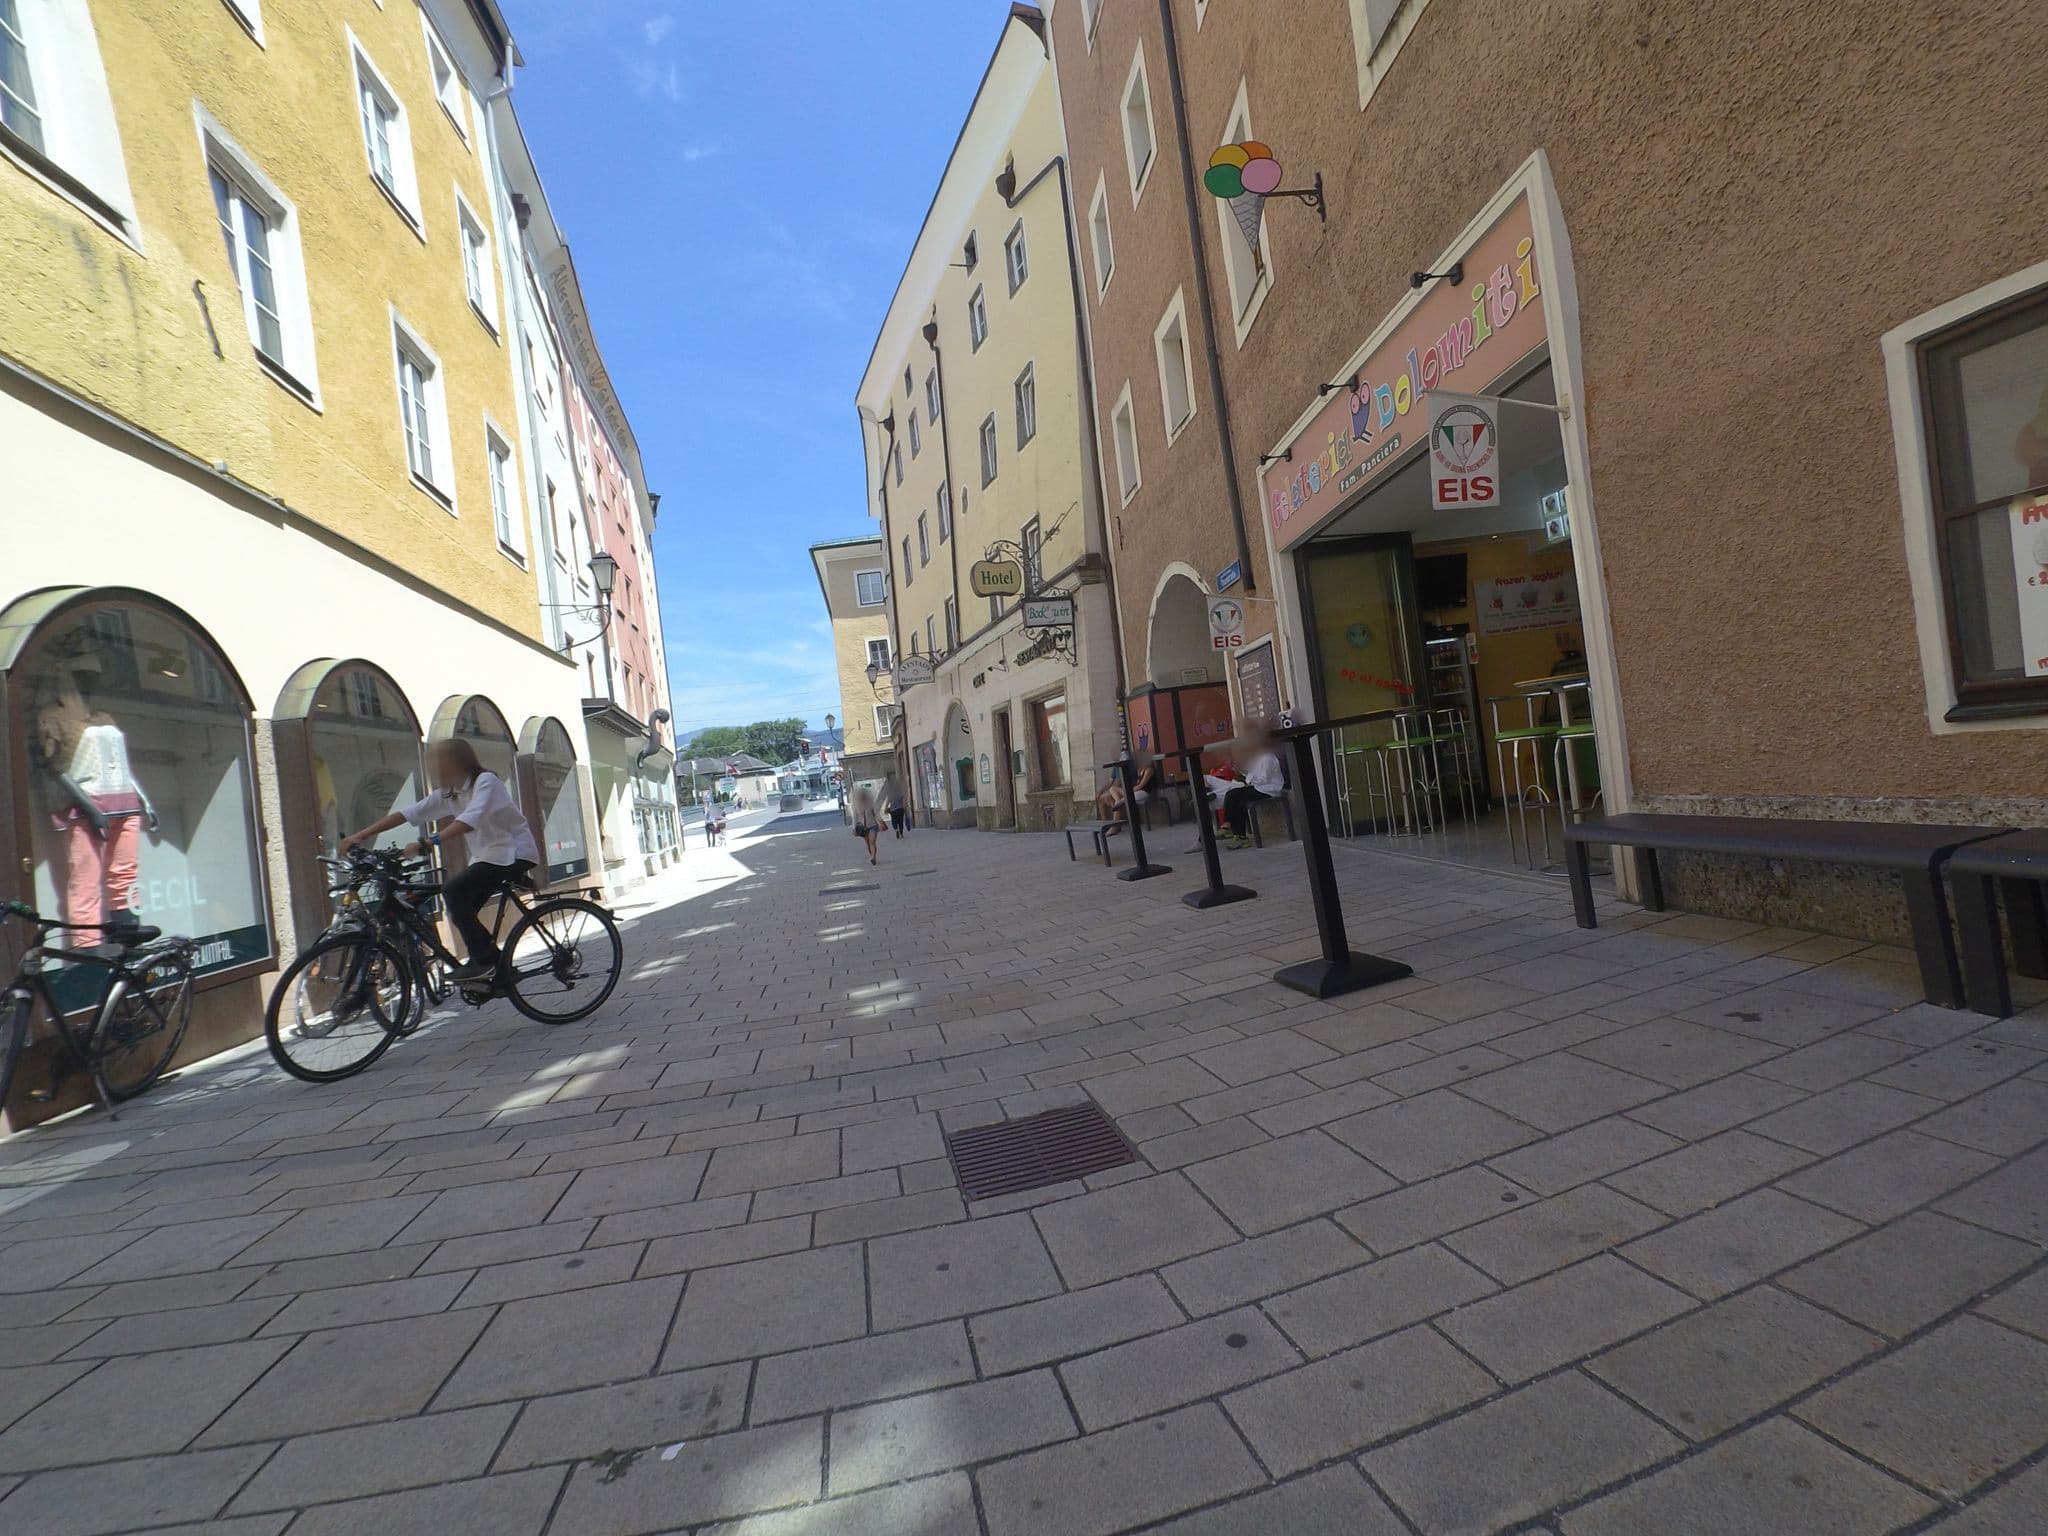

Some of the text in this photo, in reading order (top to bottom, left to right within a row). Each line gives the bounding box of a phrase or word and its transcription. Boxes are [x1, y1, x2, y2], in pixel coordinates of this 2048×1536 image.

[1375, 236, 1541, 432] Dolomiti
[1340, 474, 1359, 493] Fam.
[1360, 436, 1401, 476] Panciera
[1438, 475, 1494, 503] EIS
[980, 570, 1014, 585] Hotel
[1214, 635, 1243, 649] EIS
[127, 875, 206, 916] CECIL
